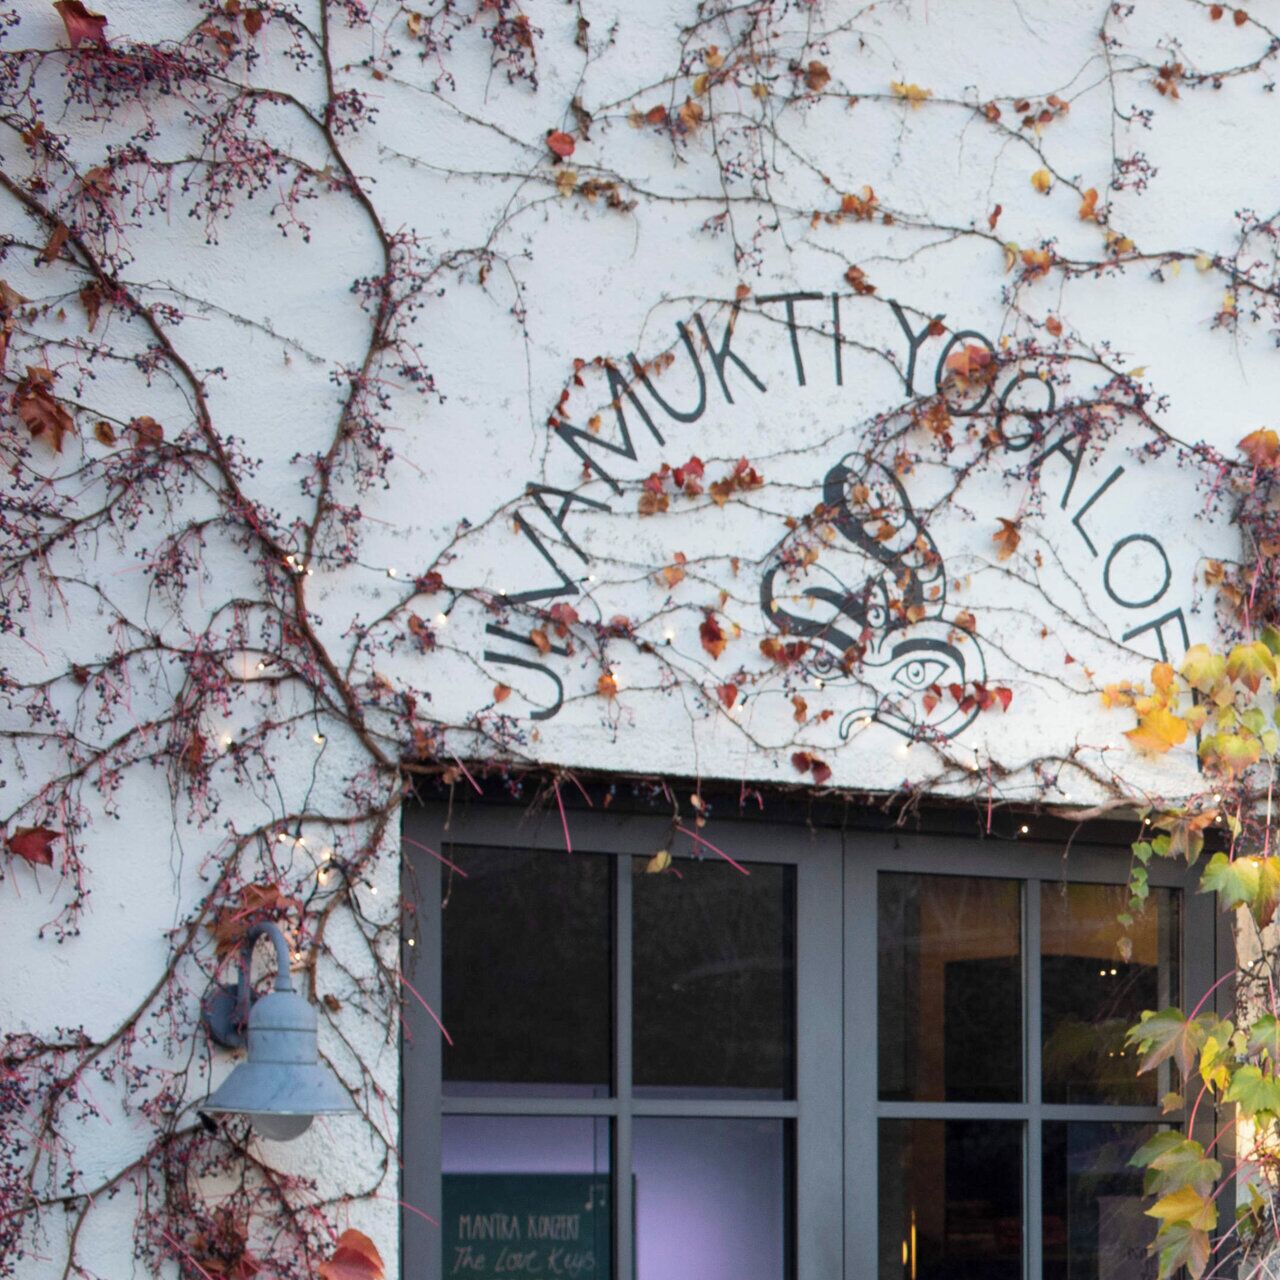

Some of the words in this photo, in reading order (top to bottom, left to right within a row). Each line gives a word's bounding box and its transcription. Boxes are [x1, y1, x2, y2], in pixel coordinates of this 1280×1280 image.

[484, 292, 843, 720] JIVAMUKTI
[458, 1213, 521, 1241] MANTRA
[450, 1245, 487, 1275] The
